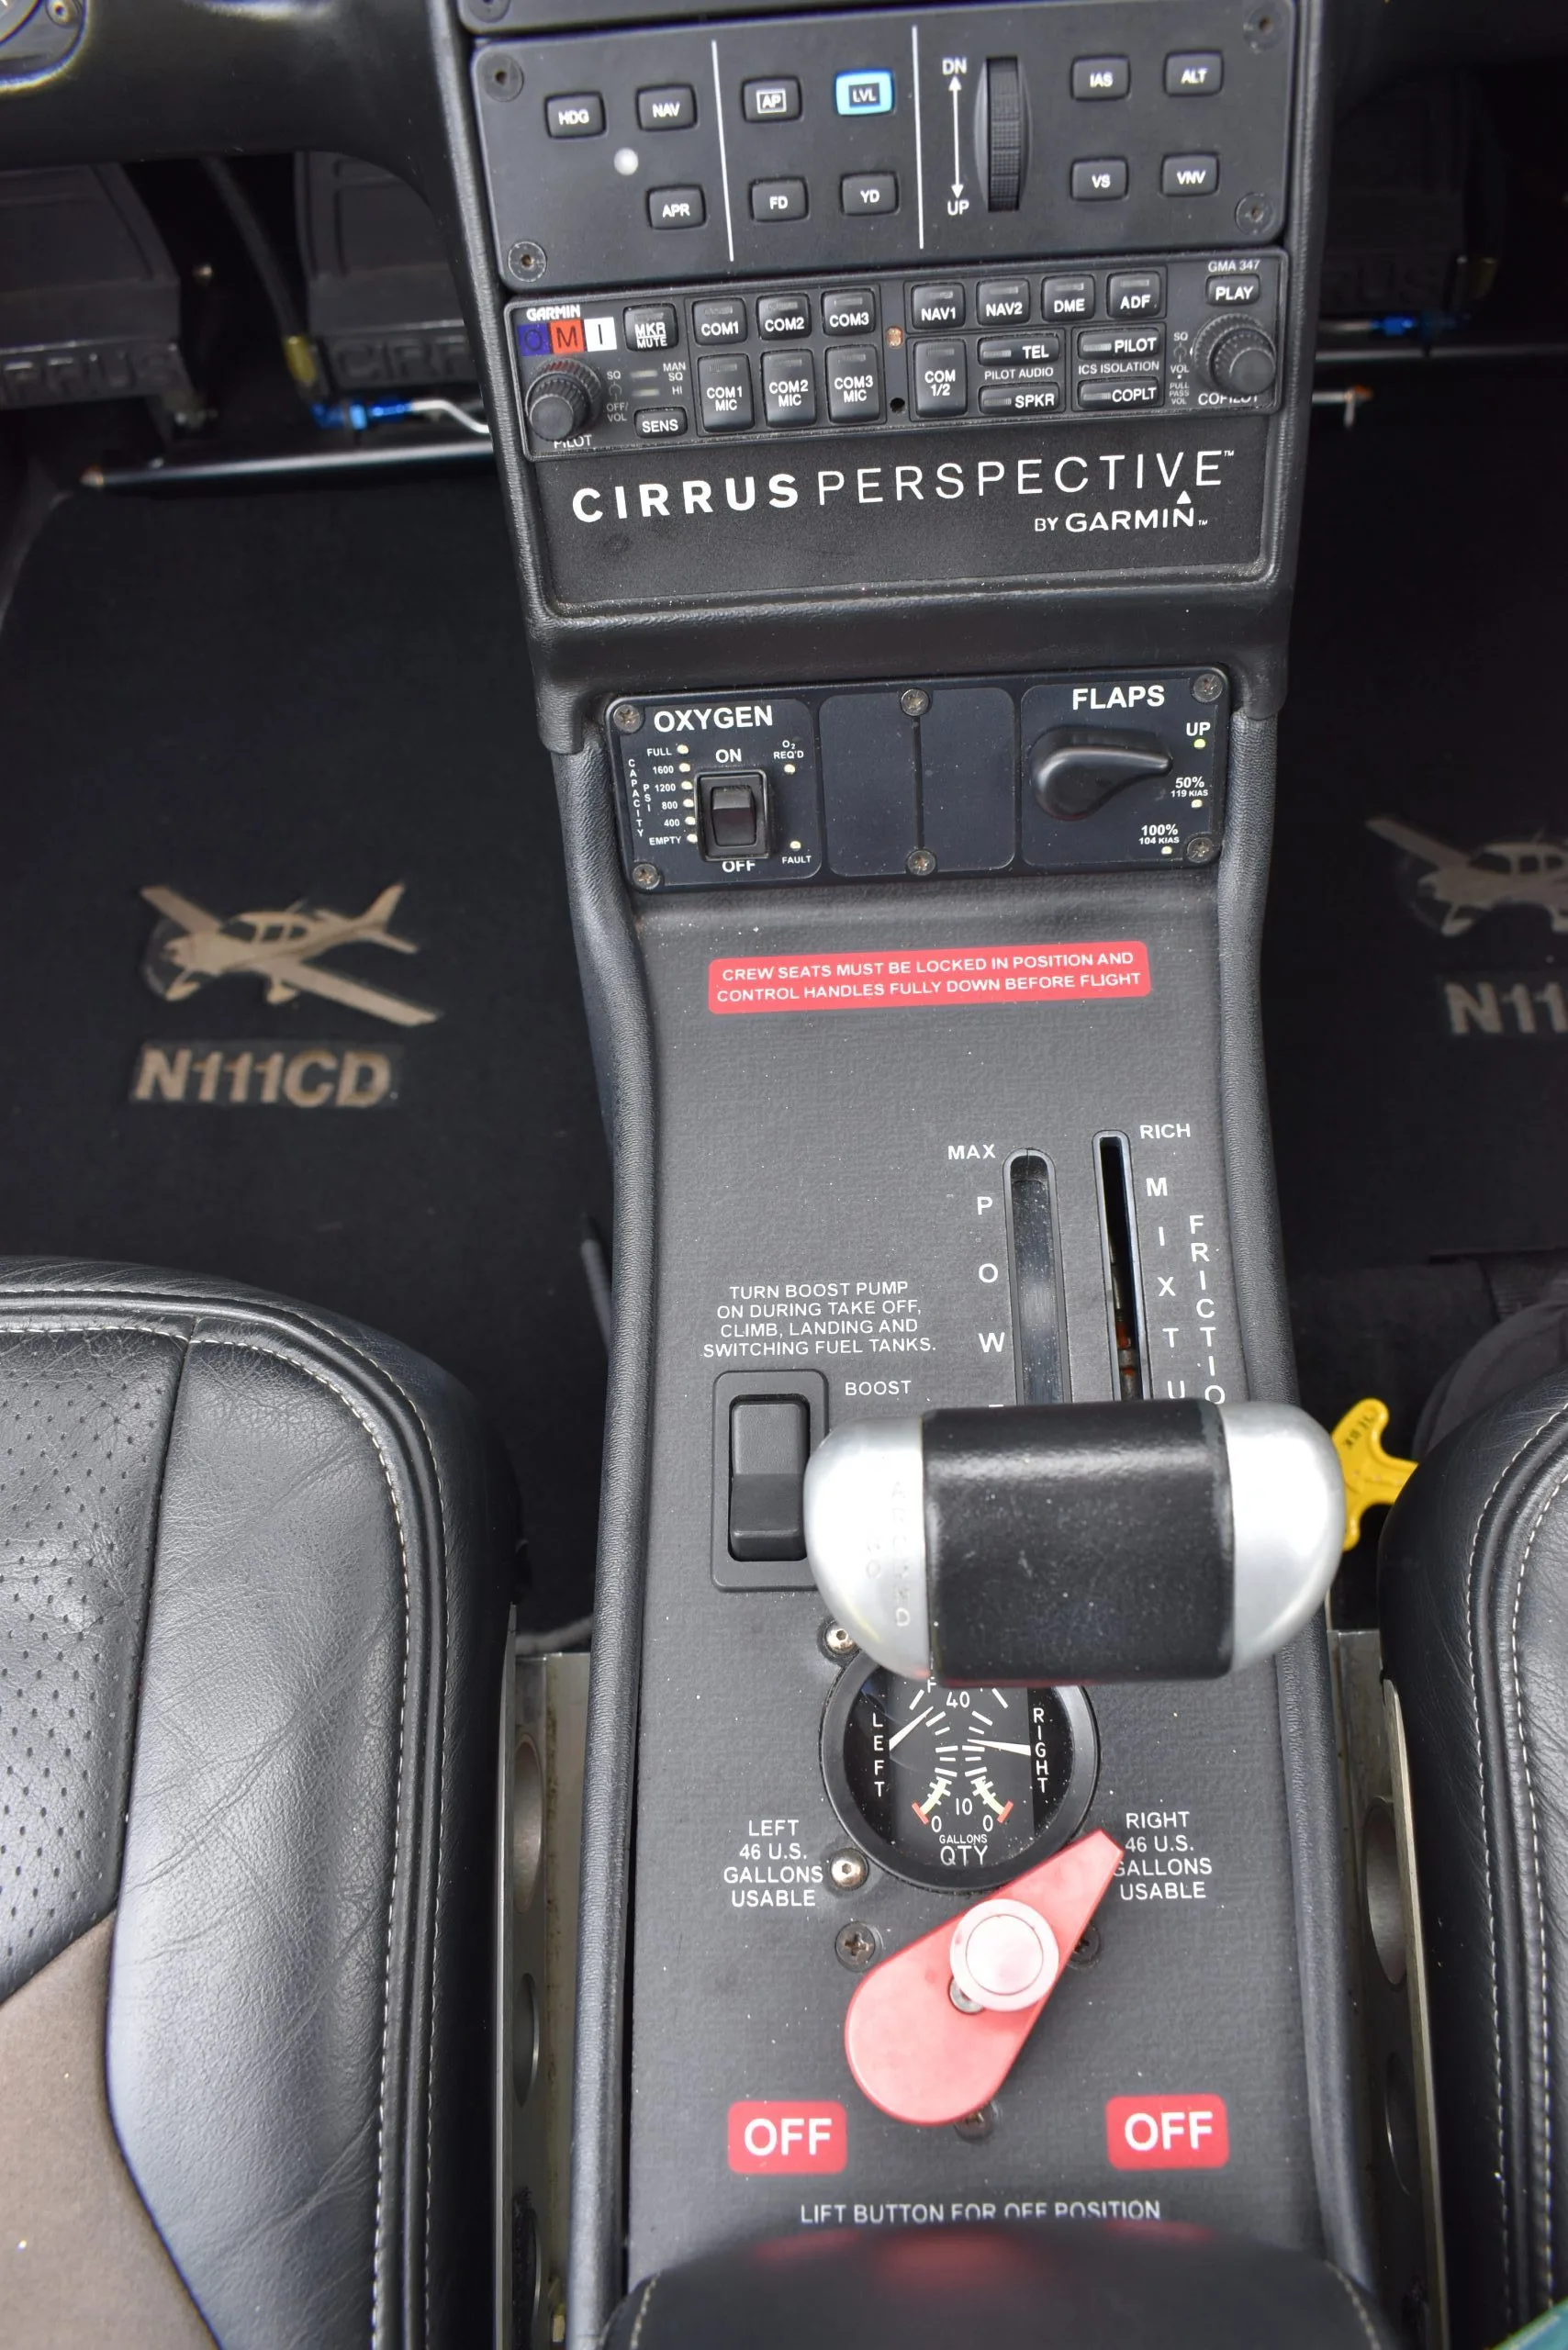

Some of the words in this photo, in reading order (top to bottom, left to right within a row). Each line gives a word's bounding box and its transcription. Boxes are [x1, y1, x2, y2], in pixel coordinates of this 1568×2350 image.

[942, 57, 968, 75] DN
[1090, 72, 1114, 88] IAS
[1181, 69, 1207, 85] ALT
[557, 108, 589, 126] HDG
[652, 102, 680, 118] NAV
[761, 93, 782, 109] AP
[852, 87, 877, 104] LVL
[1091, 173, 1112, 189] VS
[1176, 171, 1206, 186] VNV
[662, 202, 690, 218] APR
[769, 196, 789, 210] FD
[859, 189, 880, 204] YD
[946, 200, 969, 216] UP
[1207, 260, 1238, 273] GMA
[1238, 259, 1260, 272] 347
[526, 304, 581, 321] GARMIN
[700, 321, 739, 337] COM1
[764, 316, 805, 332] COM2
[829, 311, 869, 328] COM3
[921, 307, 957, 321] NAV1
[985, 301, 1023, 317] NAV2
[1054, 297, 1086, 313] DME
[1120, 294, 1151, 309] ADF
[1215, 285, 1254, 301] PLAY
[555, 325, 579, 349] M
[634, 321, 666, 337] MKR
[636, 336, 668, 349] MUTE
[1114, 337, 1158, 353] PILOT
[1022, 344, 1049, 360] TEL
[663, 362, 687, 372] MAN
[984, 368, 1015, 381] PILOT
[1018, 366, 1054, 379] AUDIO
[1078, 363, 1098, 375] ICS
[1100, 360, 1160, 374] ISOLATION
[1170, 364, 1190, 375] VOL
[606, 370, 622, 381] SQ
[834, 375, 874, 390] COM3
[924, 369, 956, 384] COM
[671, 386, 683, 396] HI
[768, 379, 809, 395] COM2
[930, 384, 951, 397] 1/2
[1111, 386, 1158, 402] COPLT
[778, 393, 802, 407] MIC
[843, 389, 868, 404] MIC
[1014, 393, 1055, 408] SPKR
[715, 398, 738, 412] MIC
[607, 412, 628, 422] VOL
[642, 419, 679, 433] SENS
[571, 471, 800, 524] CIRRUS
[1034, 517, 1059, 532] BY
[1072, 684, 1166, 711] FLAPS
[653, 704, 773, 733] OXYGEN
[1185, 722, 1211, 737] UP
[646, 747, 672, 757] FULL
[715, 748, 742, 764] ON
[652, 766, 674, 775] 1600
[654, 783, 677, 793] 1200
[1175, 776, 1205, 789] 50%
[1170, 789, 1187, 798] 119
[1188, 789, 1209, 797] KIAS
[661, 801, 678, 811] 800
[664, 819, 680, 827] 400
[1140, 823, 1179, 836] 100%
[648, 835, 682, 846] EMPTY
[1138, 836, 1156, 845] 104
[1158, 836, 1180, 845] KIAS
[722, 860, 756, 873] OFF
[781, 855, 812, 865] FAULT
[722, 966, 776, 982] CREW
[778, 964, 832, 979] SEATS
[836, 962, 884, 977] MUST
[888, 960, 912, 975] BE
[916, 957, 987, 974] LOCKED
[991, 957, 1009, 970] IN
[1013, 953, 1093, 969] POSITION
[1096, 951, 1134, 966] AND
[716, 987, 800, 1002] CONTROL
[803, 983, 885, 1000] HANDLES
[890, 979, 942, 995] FULLY
[946, 978, 1001, 993] DOWN
[1004, 974, 1075, 990] BEFORE
[1080, 971, 1141, 988] FLIGHT
[134, 1046, 393, 1109] N111CD
[1139, 1123, 1192, 1140] RICH
[946, 1143, 997, 1161] MAX
[728, 1285, 780, 1300] TURN
[785, 1282, 851, 1298] BOOST
[856, 1281, 909, 1296] PUMP
[716, 1304, 745, 1319] ON
[749, 1302, 823, 1318] DURING
[828, 1300, 876, 1315] TAKE
[881, 1299, 922, 1315] OFF,
[976, 1195, 1006, 1408] POW
[789, 1319, 874, 1337] LANDING
[878, 1318, 919, 1333] AND
[703, 1340, 810, 1359] SWITCHING
[814, 1338, 864, 1355] FUEL
[868, 1337, 936, 1353] TANKS.
[844, 1380, 913, 1396] BOOST
[946, 1690, 971, 1708] 40
[955, 1797, 973, 1816] 10
[748, 1819, 800, 1837] LEFT
[931, 1815, 943, 1833] 0
[982, 1814, 994, 1832] 0
[1126, 1810, 1191, 1830] RIGHT
[939, 1833, 988, 1844] GALLONS
[1125, 1836, 1148, 1853] 46
[1153, 1834, 1194, 1853] U.S.
[738, 1842, 762, 1861] 46
[768, 1842, 808, 1861] U.S.
[940, 1845, 989, 1866] QTY
[723, 1865, 824, 1885] GALLONS
[731, 1888, 817, 1908] USABLE
[1119, 1881, 1207, 1901] USABLE
[743, 2117, 833, 2157] OFF
[1124, 2110, 1214, 2153] OFF
[800, 2203, 847, 2224] LIFT
[854, 2202, 945, 2224] BUTTON
[951, 2202, 996, 2222] FOR
